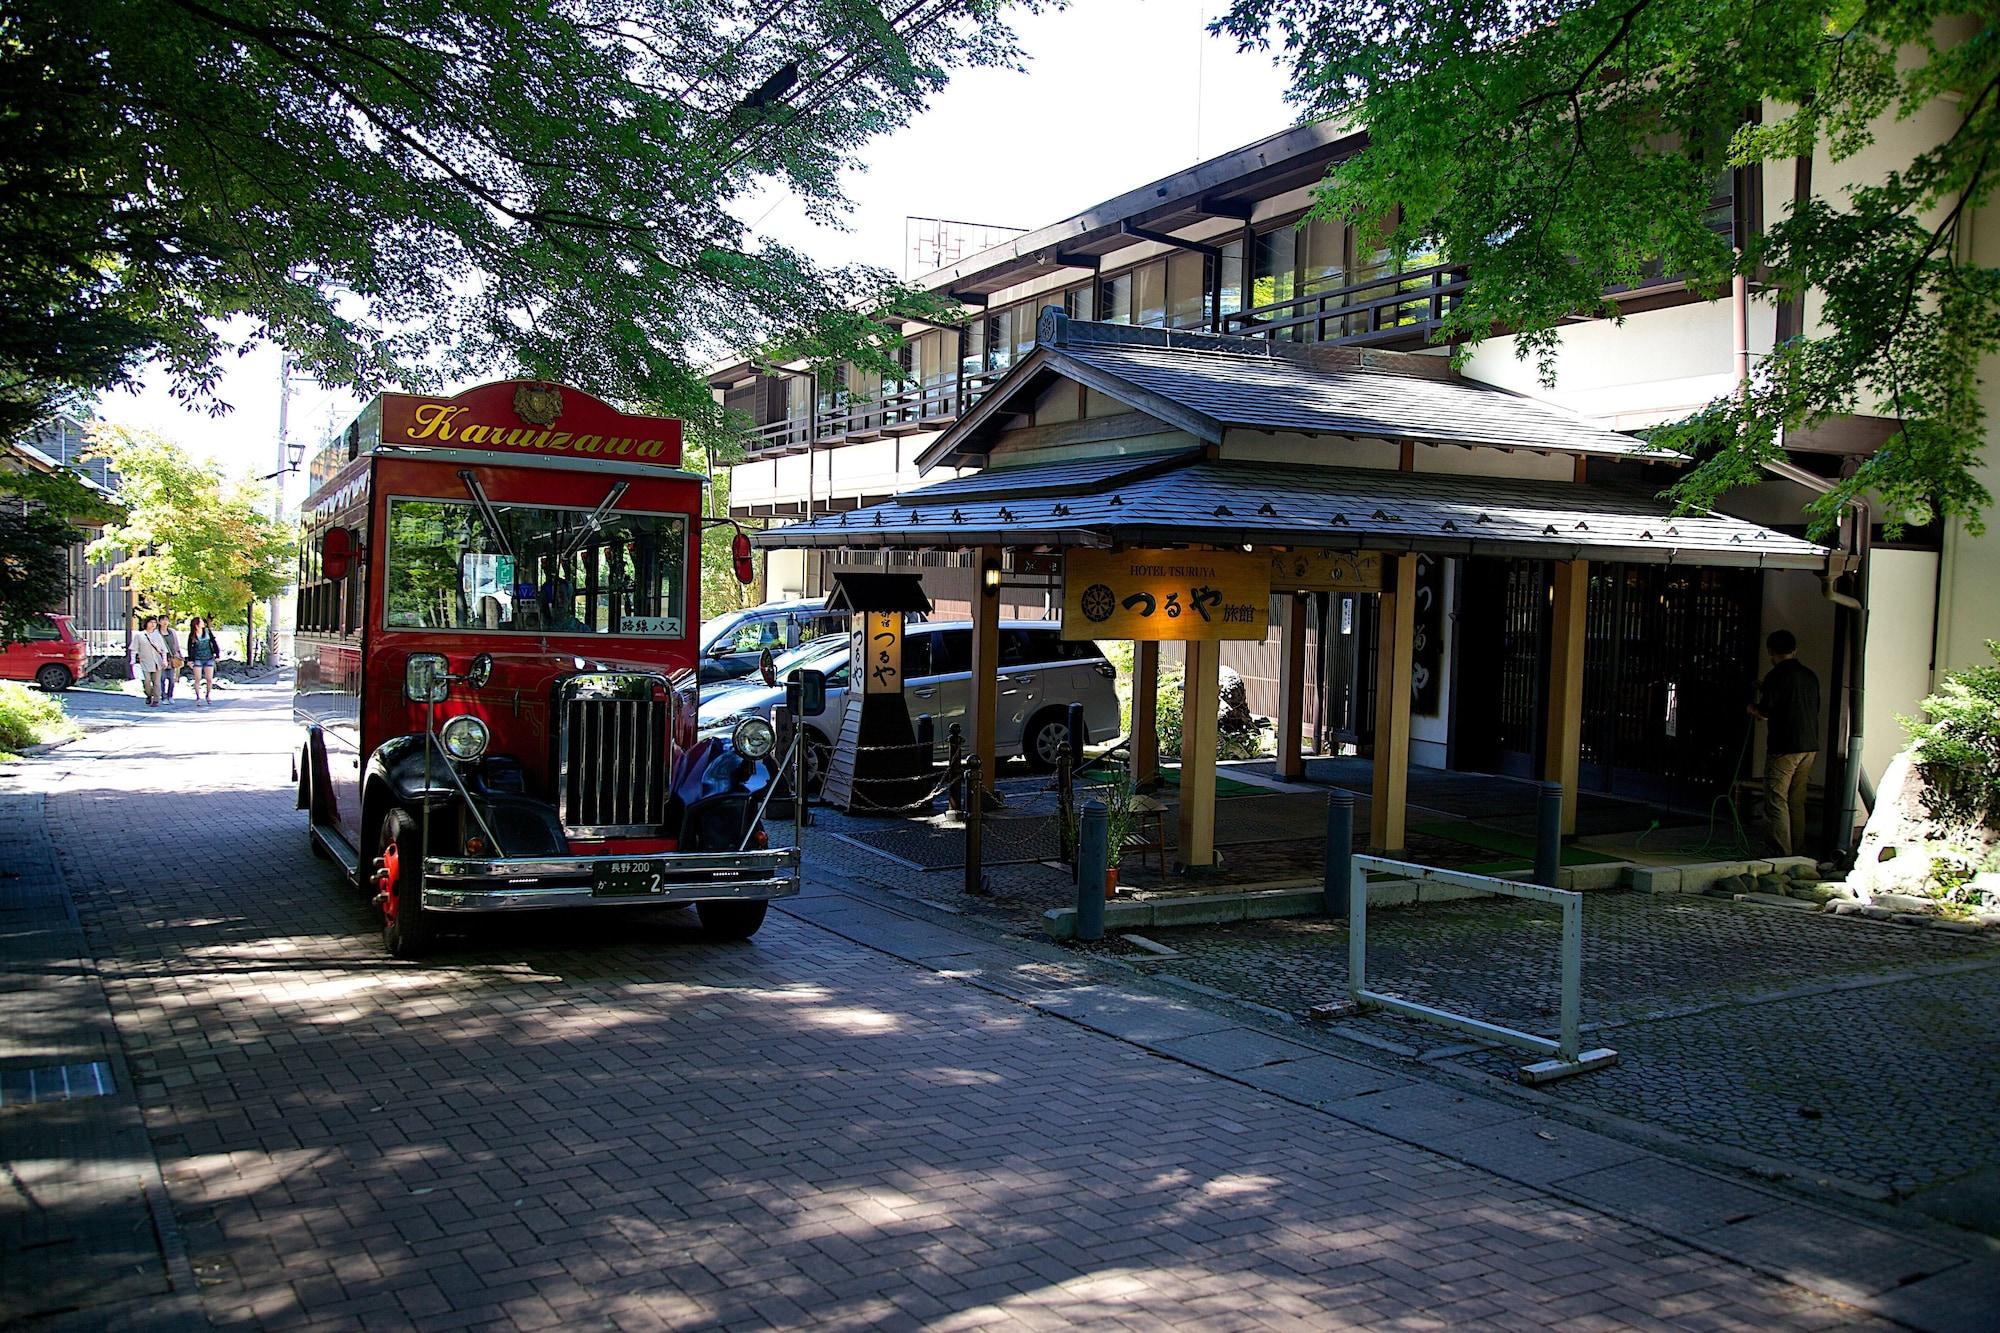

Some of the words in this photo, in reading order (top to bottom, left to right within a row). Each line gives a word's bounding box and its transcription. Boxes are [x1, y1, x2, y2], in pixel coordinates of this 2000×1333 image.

[406, 403, 665, 457] Karuizawa
[1130, 565, 1166, 577] HOTEL
[1168, 566, 1216, 578] TSURUYA
